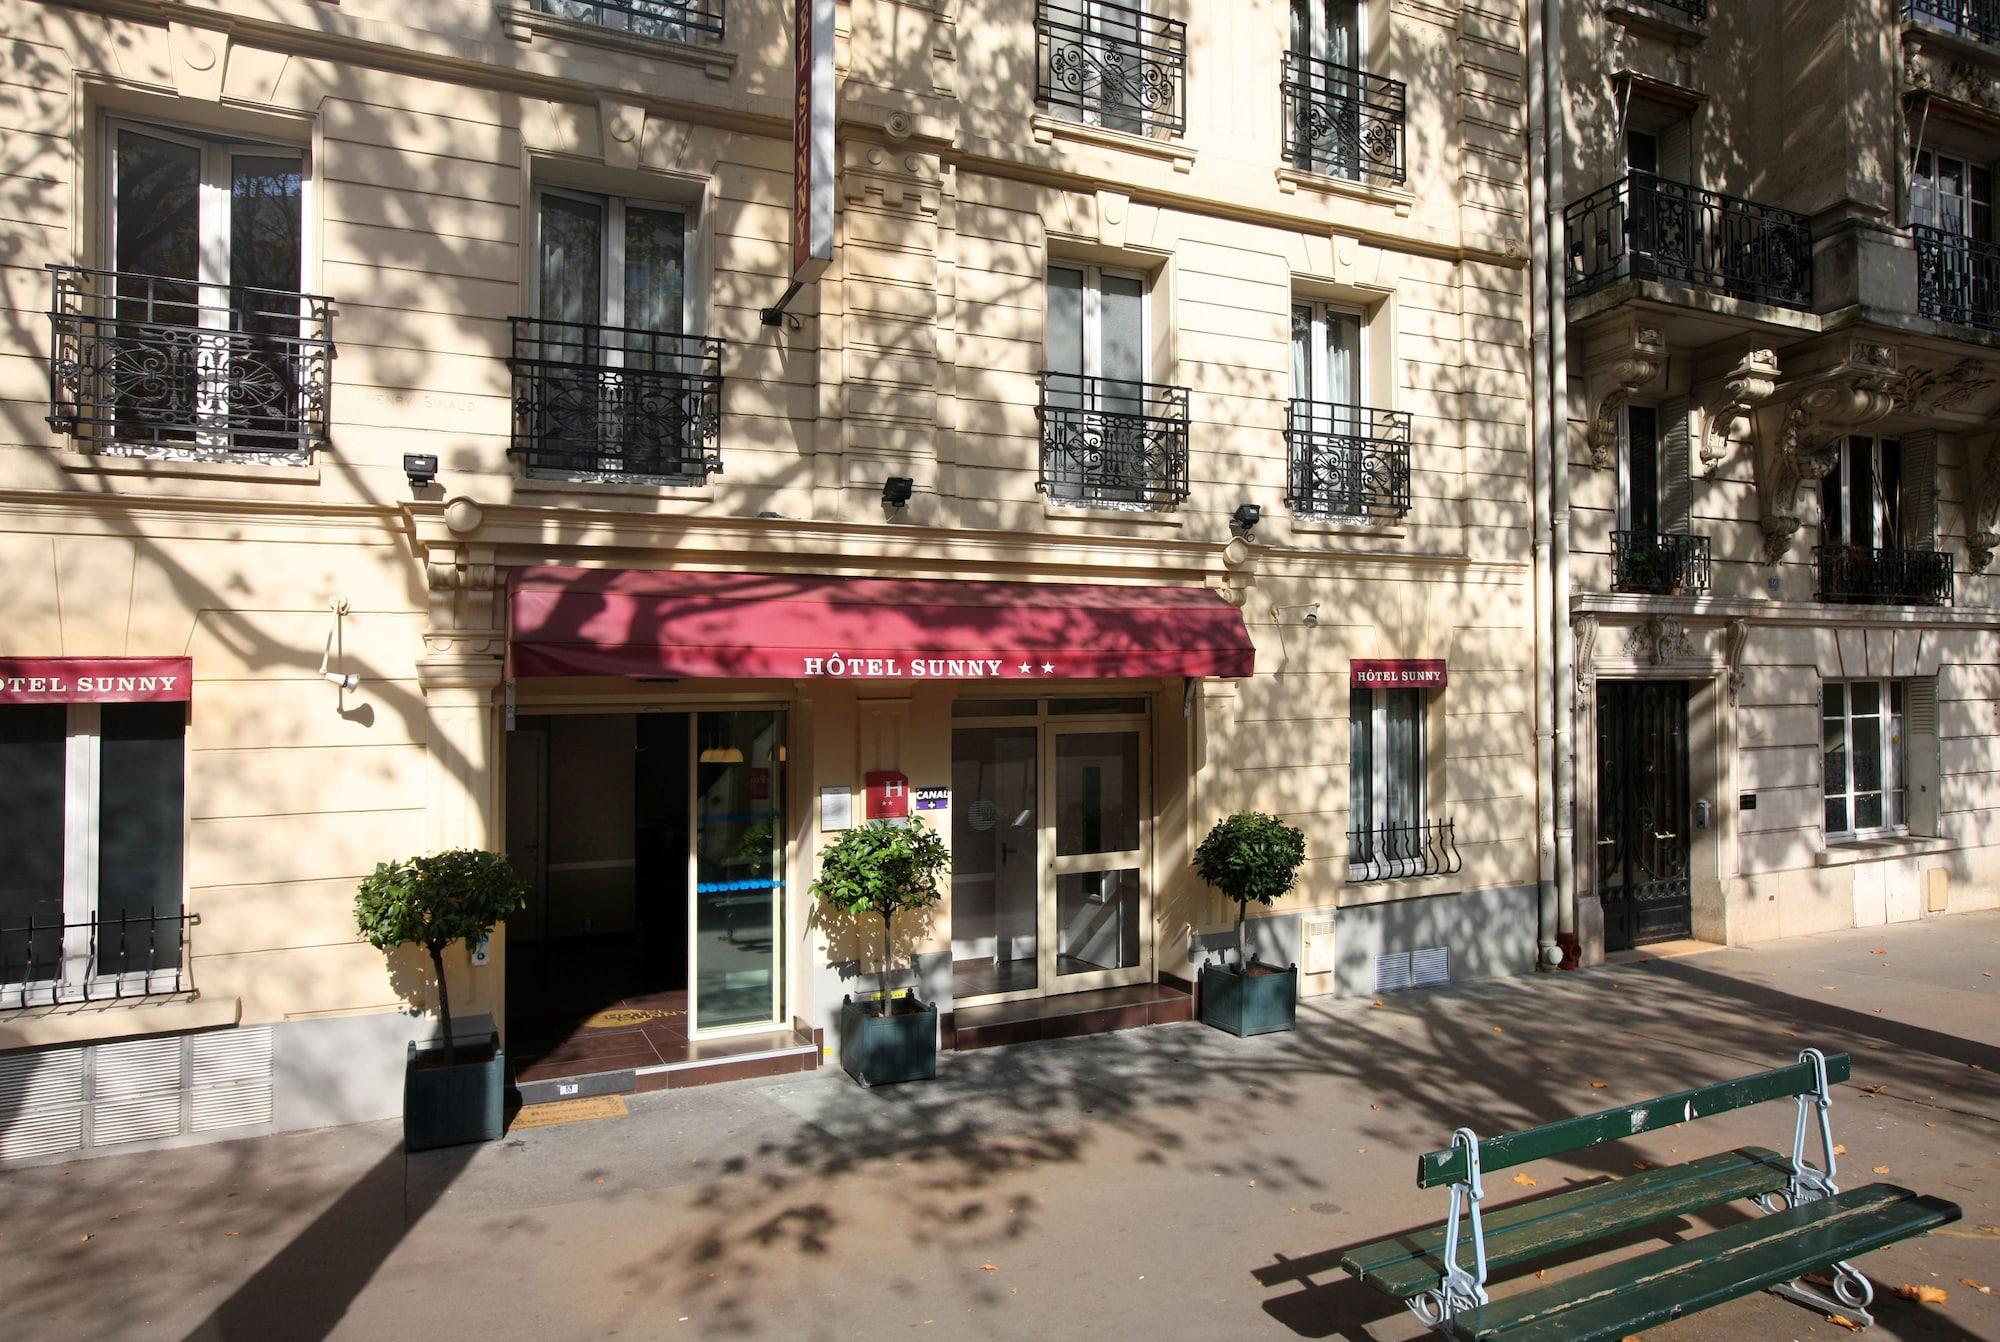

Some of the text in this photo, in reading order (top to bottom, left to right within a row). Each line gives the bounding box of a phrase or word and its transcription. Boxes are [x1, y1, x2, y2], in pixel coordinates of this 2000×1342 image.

[797, 0, 809, 246] EL SUNNY
[803, 652, 1002, 676] HÔTEL SUNNY
[1357, 669, 1441, 681] HÔTEL SUNNY
[77, 677, 177, 692] SUNNY
[885, 780, 903, 798] H
[916, 791, 949, 800] CANAL
